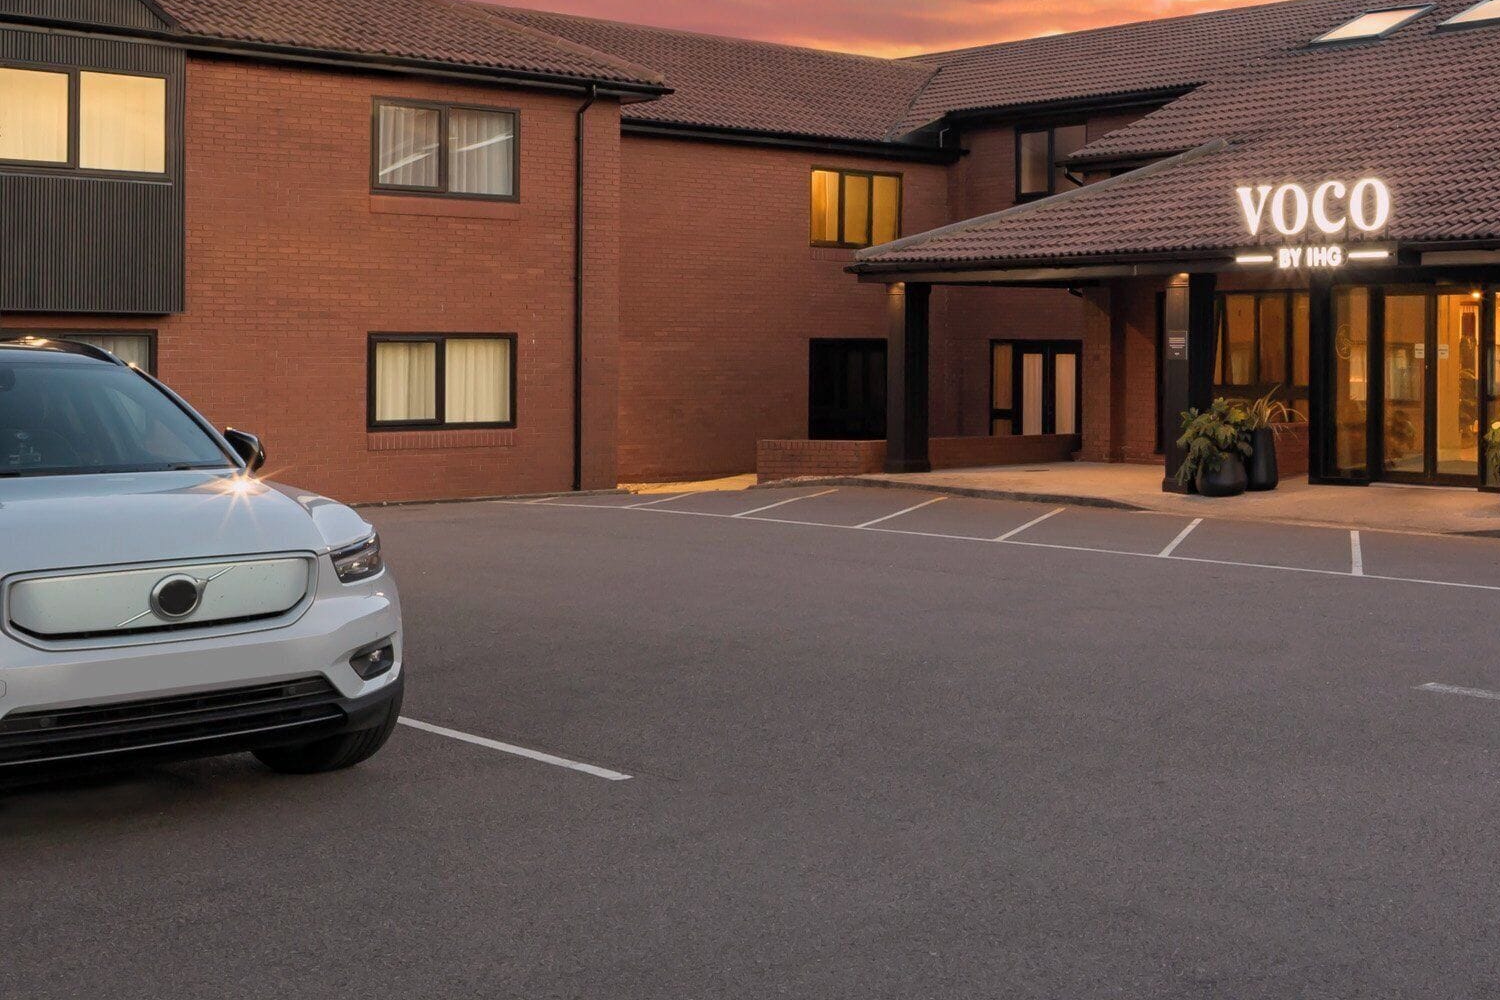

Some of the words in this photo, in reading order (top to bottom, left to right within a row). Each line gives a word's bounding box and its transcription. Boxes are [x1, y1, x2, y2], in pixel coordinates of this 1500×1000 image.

[1236, 177, 1390, 236] VOCO
[1279, 247, 1302, 269] BY
[1307, 246, 1342, 267] IHG
